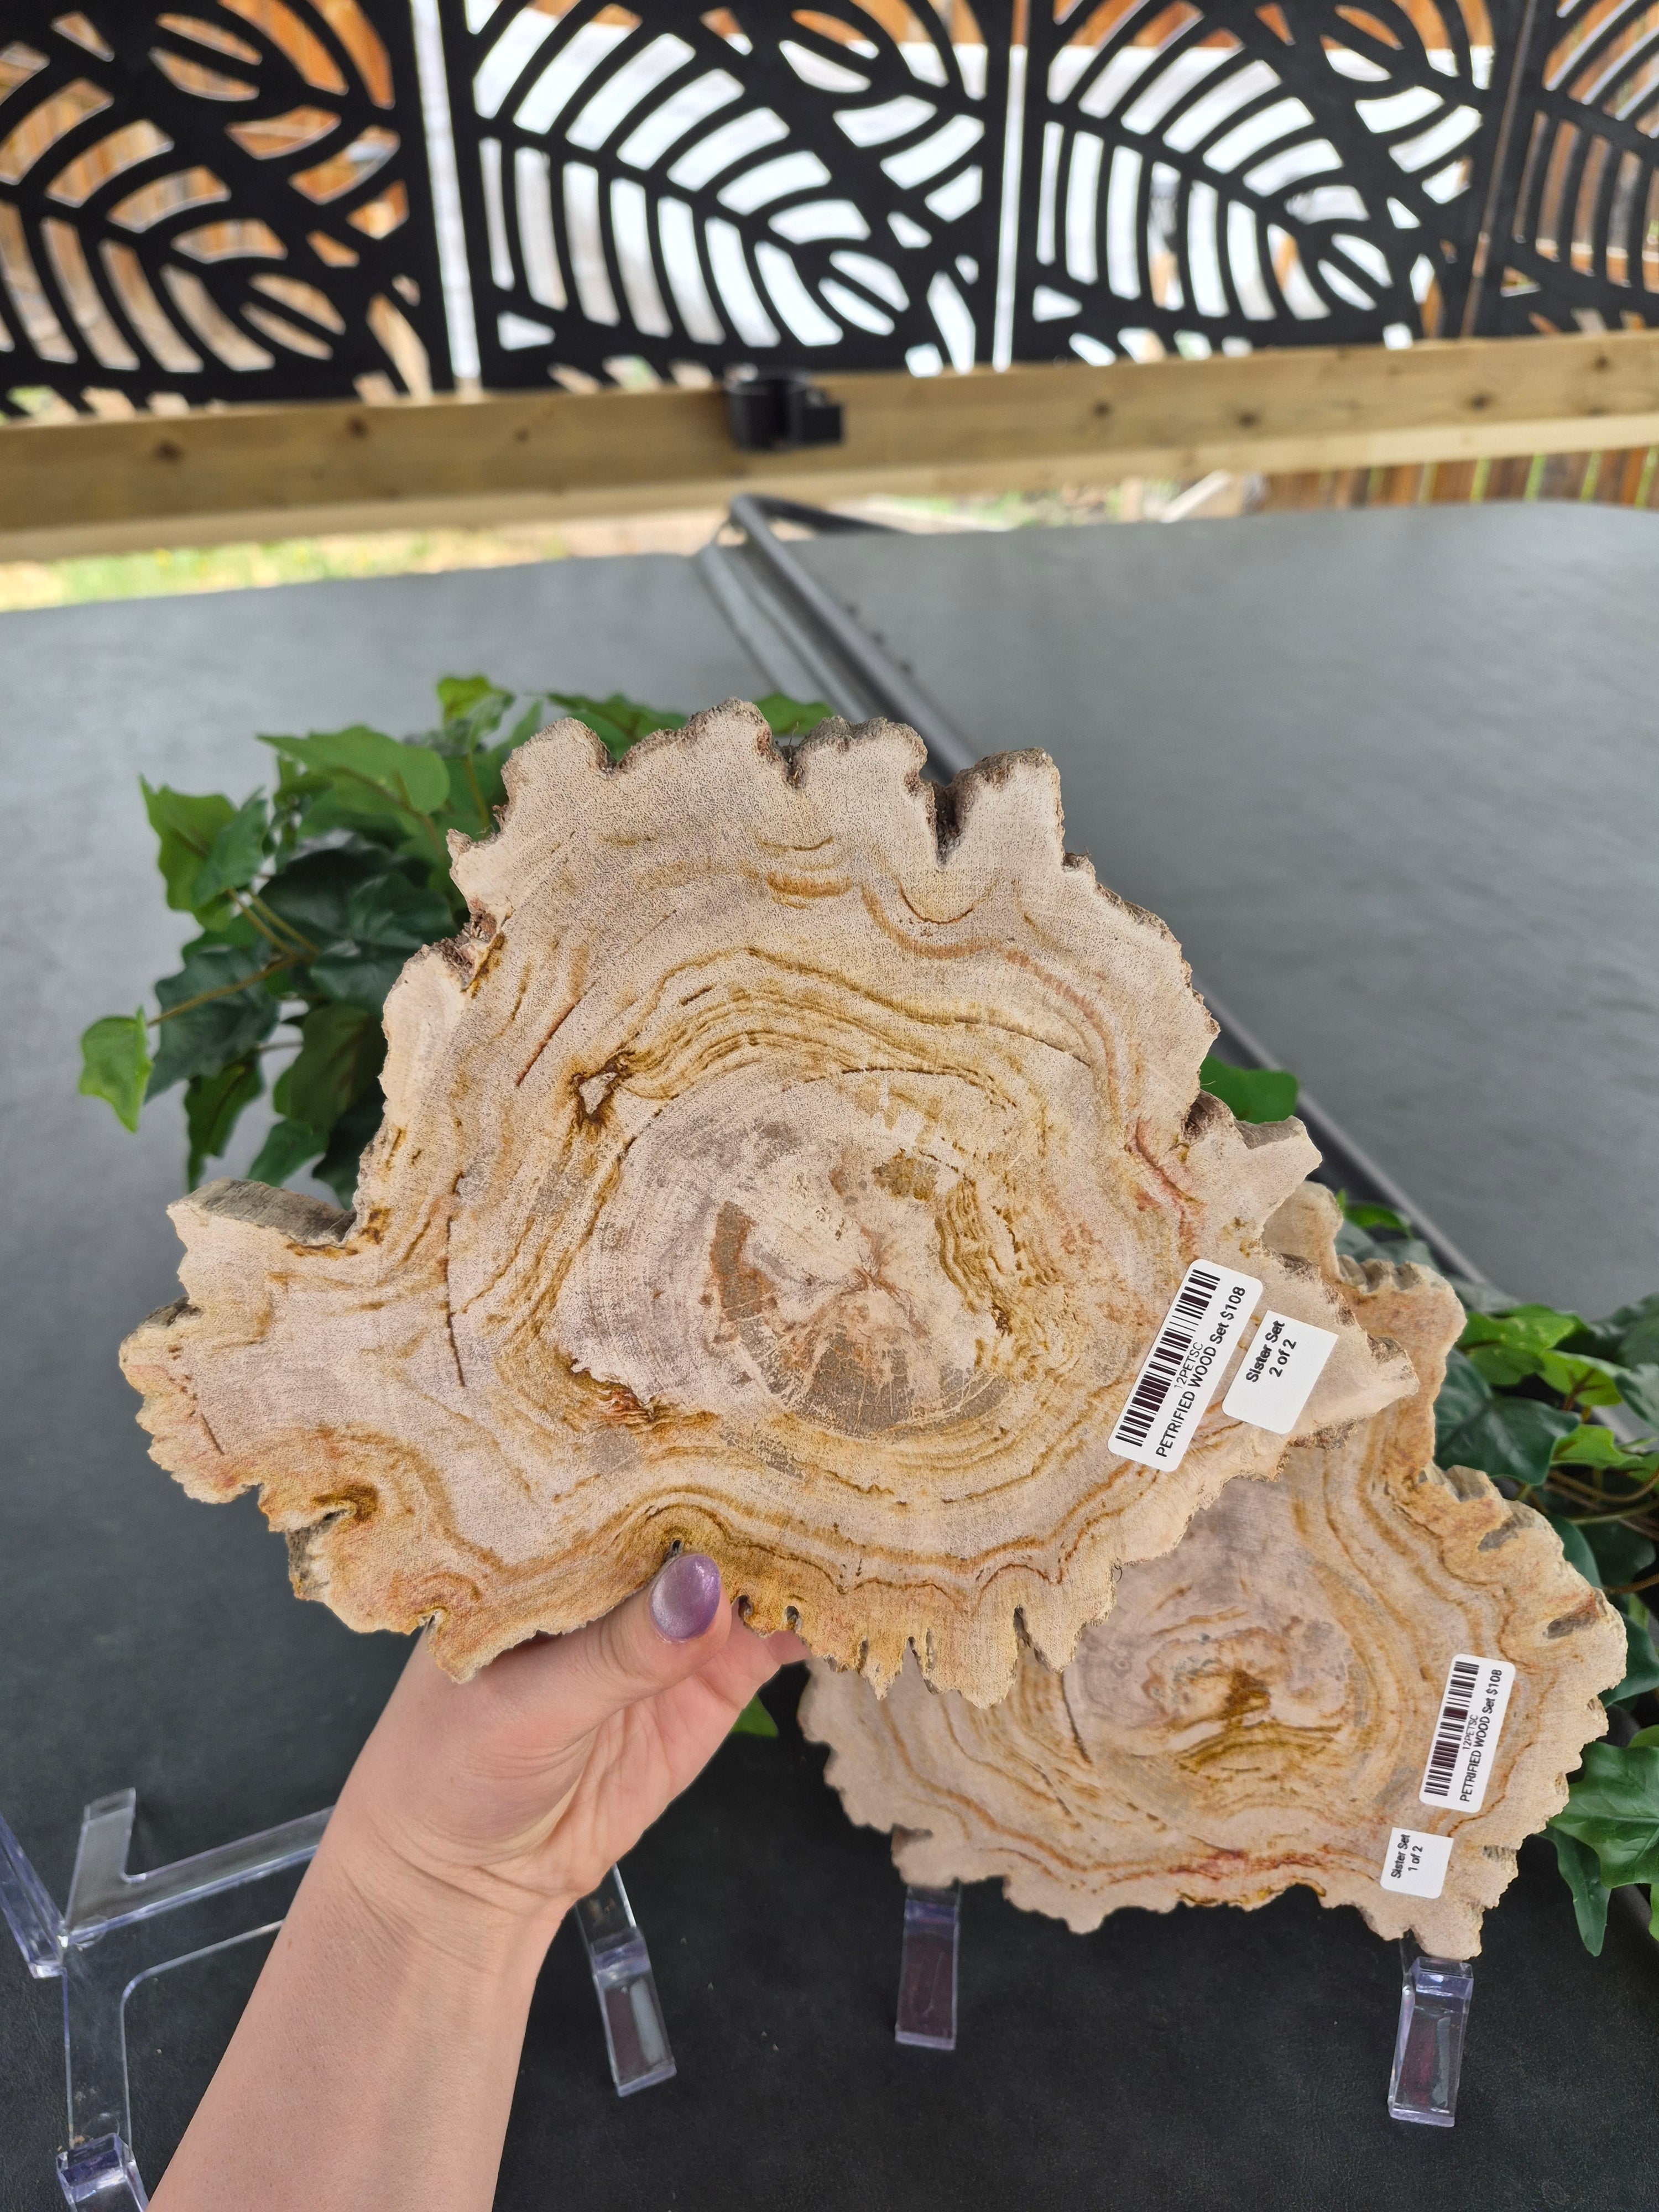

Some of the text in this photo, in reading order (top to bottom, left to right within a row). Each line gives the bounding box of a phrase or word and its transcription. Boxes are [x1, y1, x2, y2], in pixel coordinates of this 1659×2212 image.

[1156, 1286, 1246, 1457] PETRIFIED WOOD Set $108
[1174, 1342, 1203, 1389] 12PETSC
[1246, 1321, 1285, 1383] Sister Set
[1269, 1339, 1297, 1378] 2 of 2
[1460, 1670, 1503, 1802] PETRIFIED WOOD Set $108
[1462, 1714, 1478, 1750] 12PETSC
[1391, 1834, 1410, 1879] Sister Set
[1411, 1854, 1421, 1864] of
